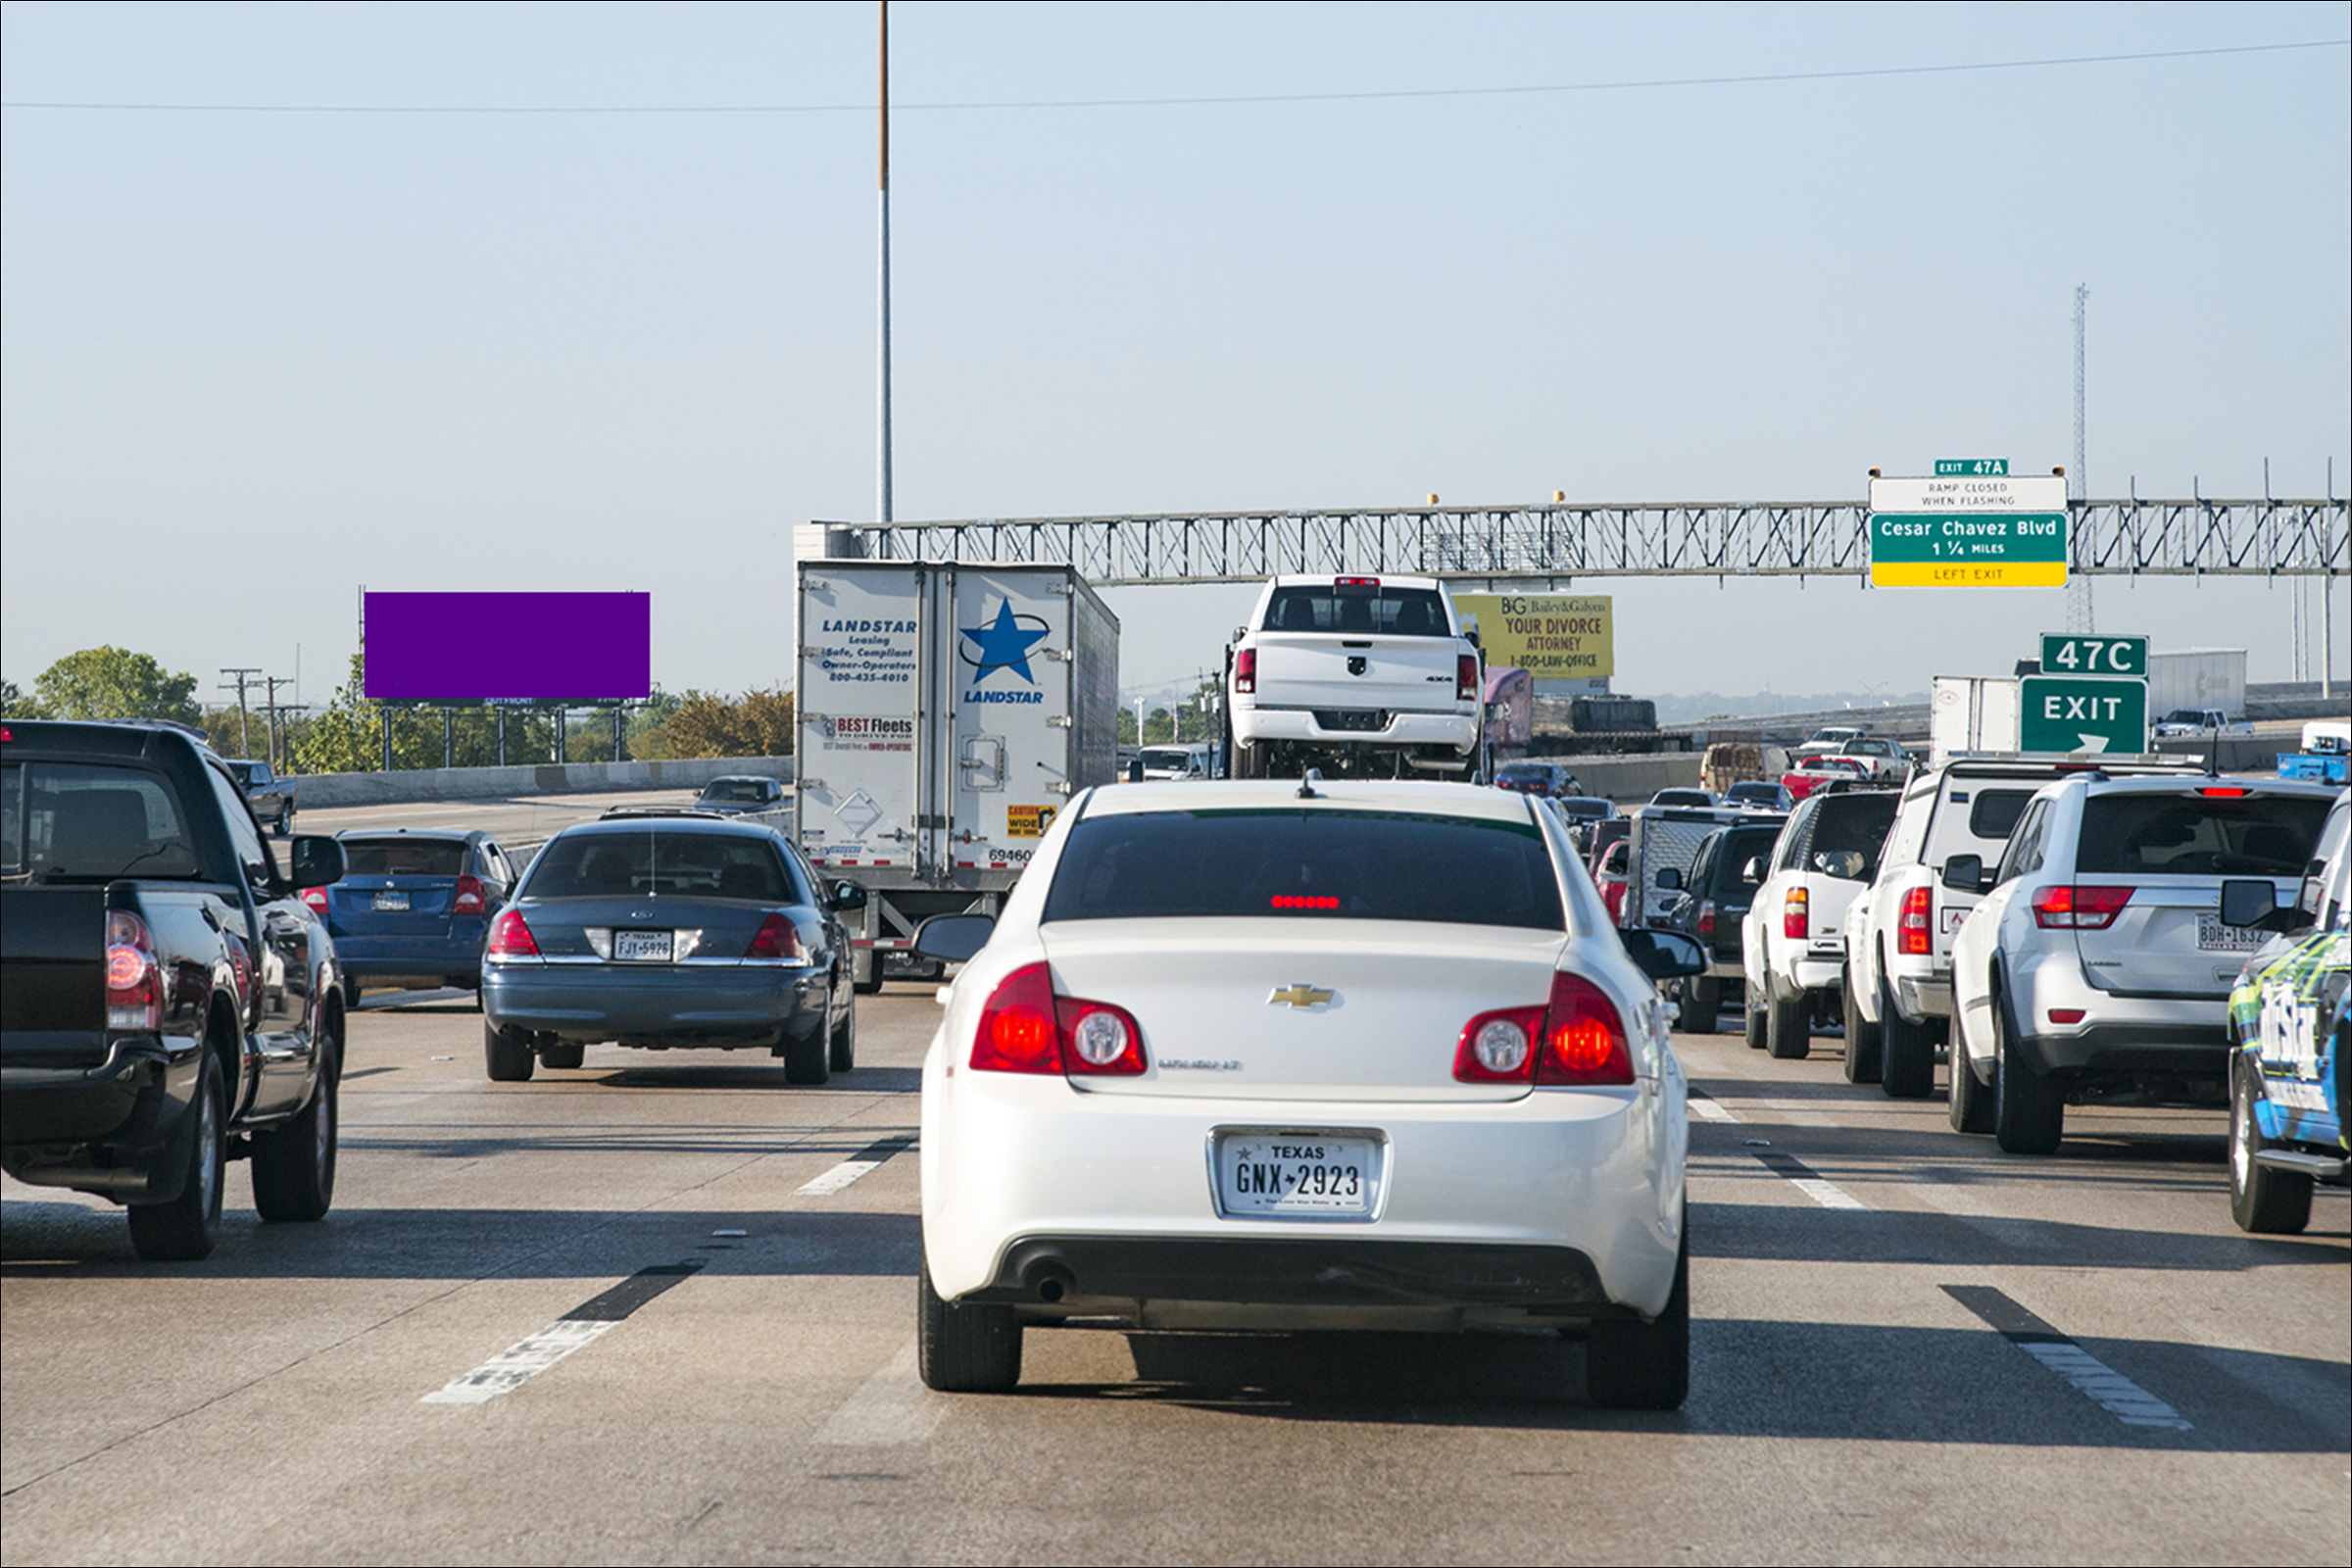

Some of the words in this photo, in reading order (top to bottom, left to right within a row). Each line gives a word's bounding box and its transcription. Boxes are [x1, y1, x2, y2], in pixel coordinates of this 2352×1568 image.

[1938, 464, 1963, 472] EXIT
[1974, 462, 2003, 474] 47A
[1965, 483, 2007, 492] CLOSED
[1922, 497, 1955, 506] WHEN
[1960, 496, 2015, 506] FLASHING
[1881, 521, 1932, 536] Cesar
[1942, 520, 2007, 536] Chavez
[2017, 520, 2056, 535] Blvd
[1933, 543, 1939, 556] 1
[1972, 545, 2004, 554] MILES
[1935, 569, 1966, 579] LEFT
[1974, 569, 2002, 579] EXIT
[822, 619, 917, 633] LANDSTAR
[1505, 617, 1542, 634] YOUR
[1546, 617, 1601, 634] DIVORCE
[849, 636, 890, 647] Leasing
[1526, 636, 1582, 651] ATTORNEY
[825, 647, 854, 658] Safe,
[857, 648, 912, 659] Compliant
[2056, 641, 2132, 670] 47C
[822, 660, 916, 671] Owner-Operators
[1510, 655, 1596, 667] 1-800-LAW-OFFICE
[829, 672, 909, 682] 800-435-4010
[963, 690, 1044, 704] LANDSTAR
[2044, 696, 2122, 720] EXIT
[838, 717, 869, 732] BEST
[871, 718, 912, 733] Fleets
[1008, 807, 1040, 815] CAUTION
[1009, 819, 1038, 828] WIDE
[989, 850, 1036, 861] 69460
[1272, 1146, 1325, 1159] TEXAS
